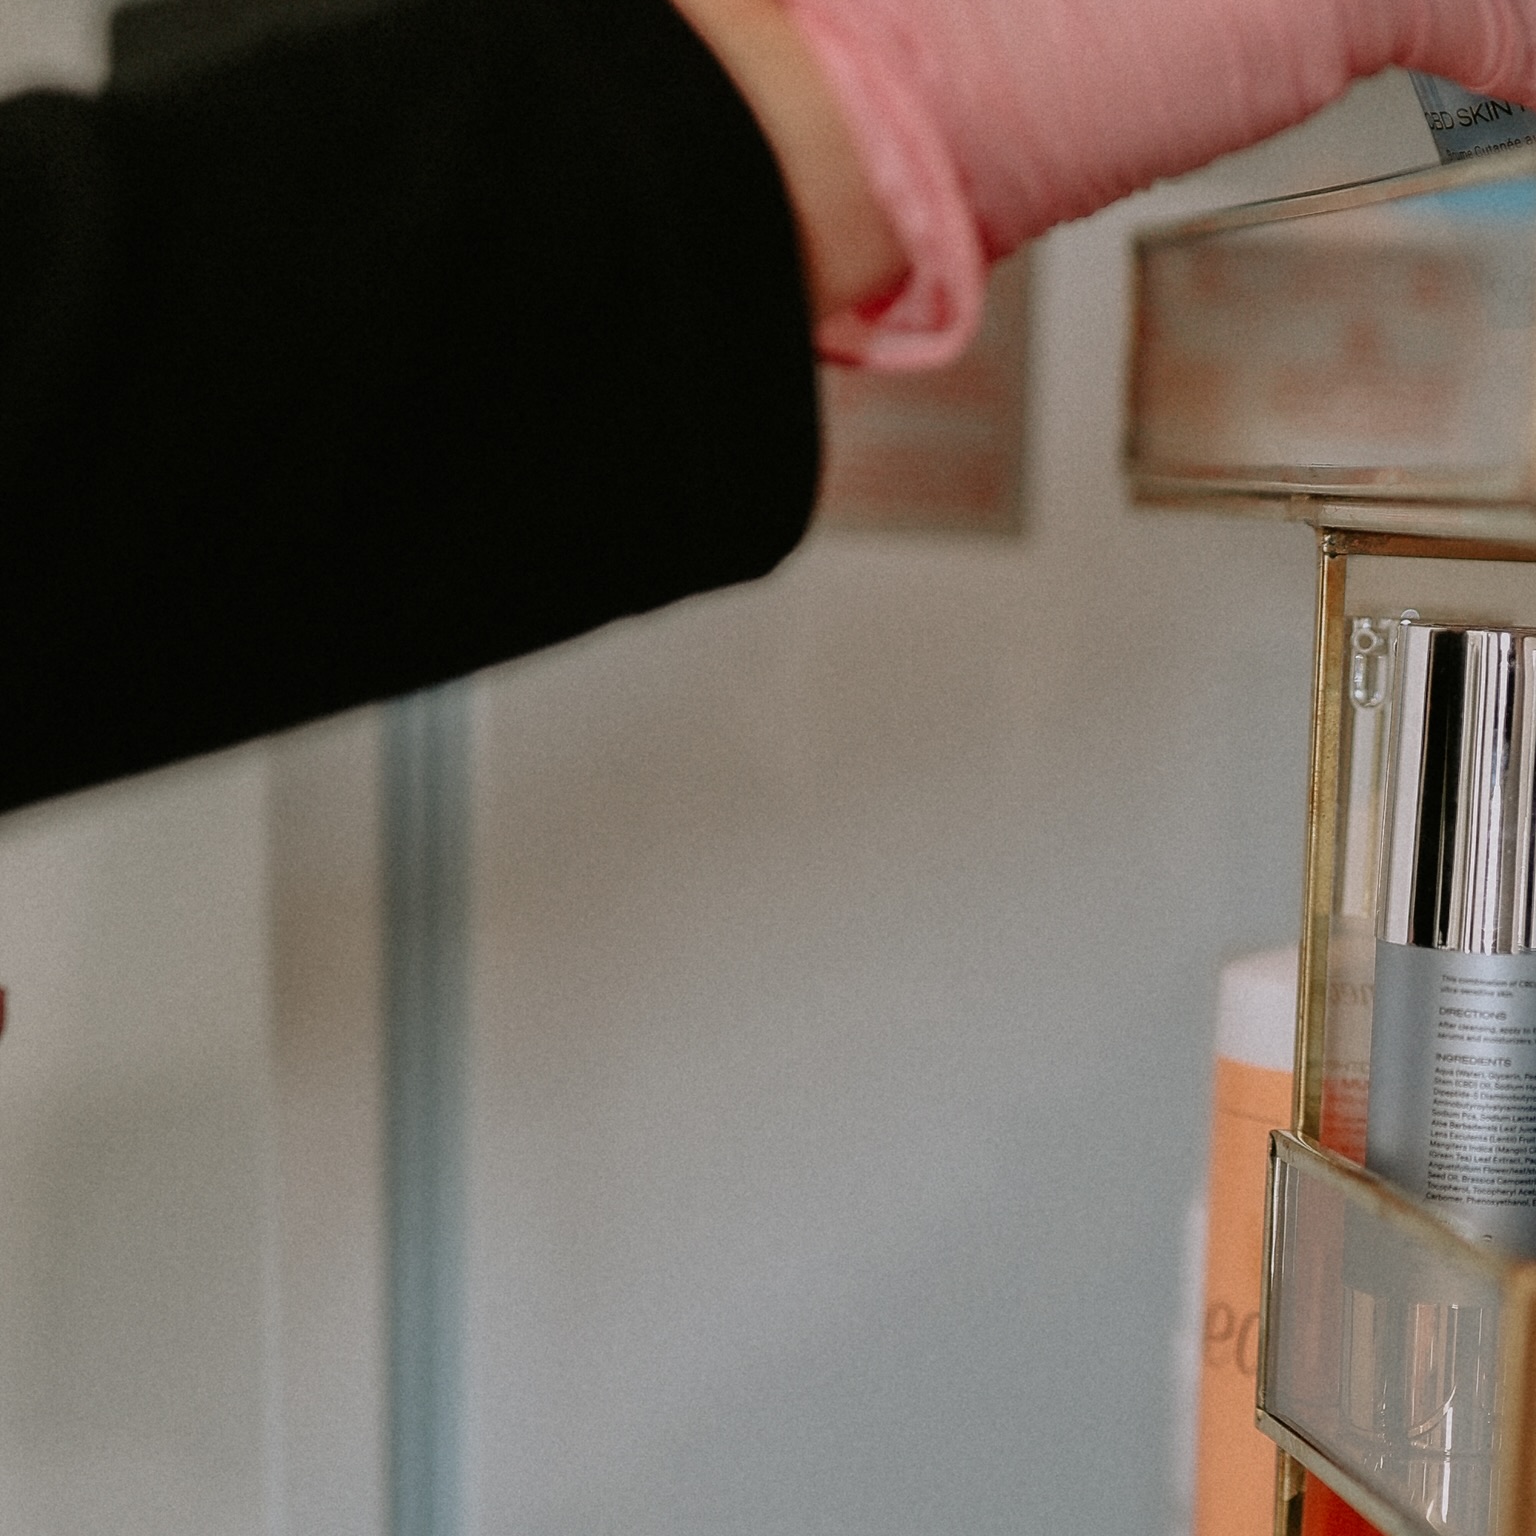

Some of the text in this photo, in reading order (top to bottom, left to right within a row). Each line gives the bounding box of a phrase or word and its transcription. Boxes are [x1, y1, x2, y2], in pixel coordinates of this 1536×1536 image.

[1457, 100, 1513, 127] SKIN
[1474, 137, 1521, 157] Cutanée
[1439, 1006, 1507, 1021] DIRECTIONS
[1436, 1053, 1512, 1068] INGREDIENTS
